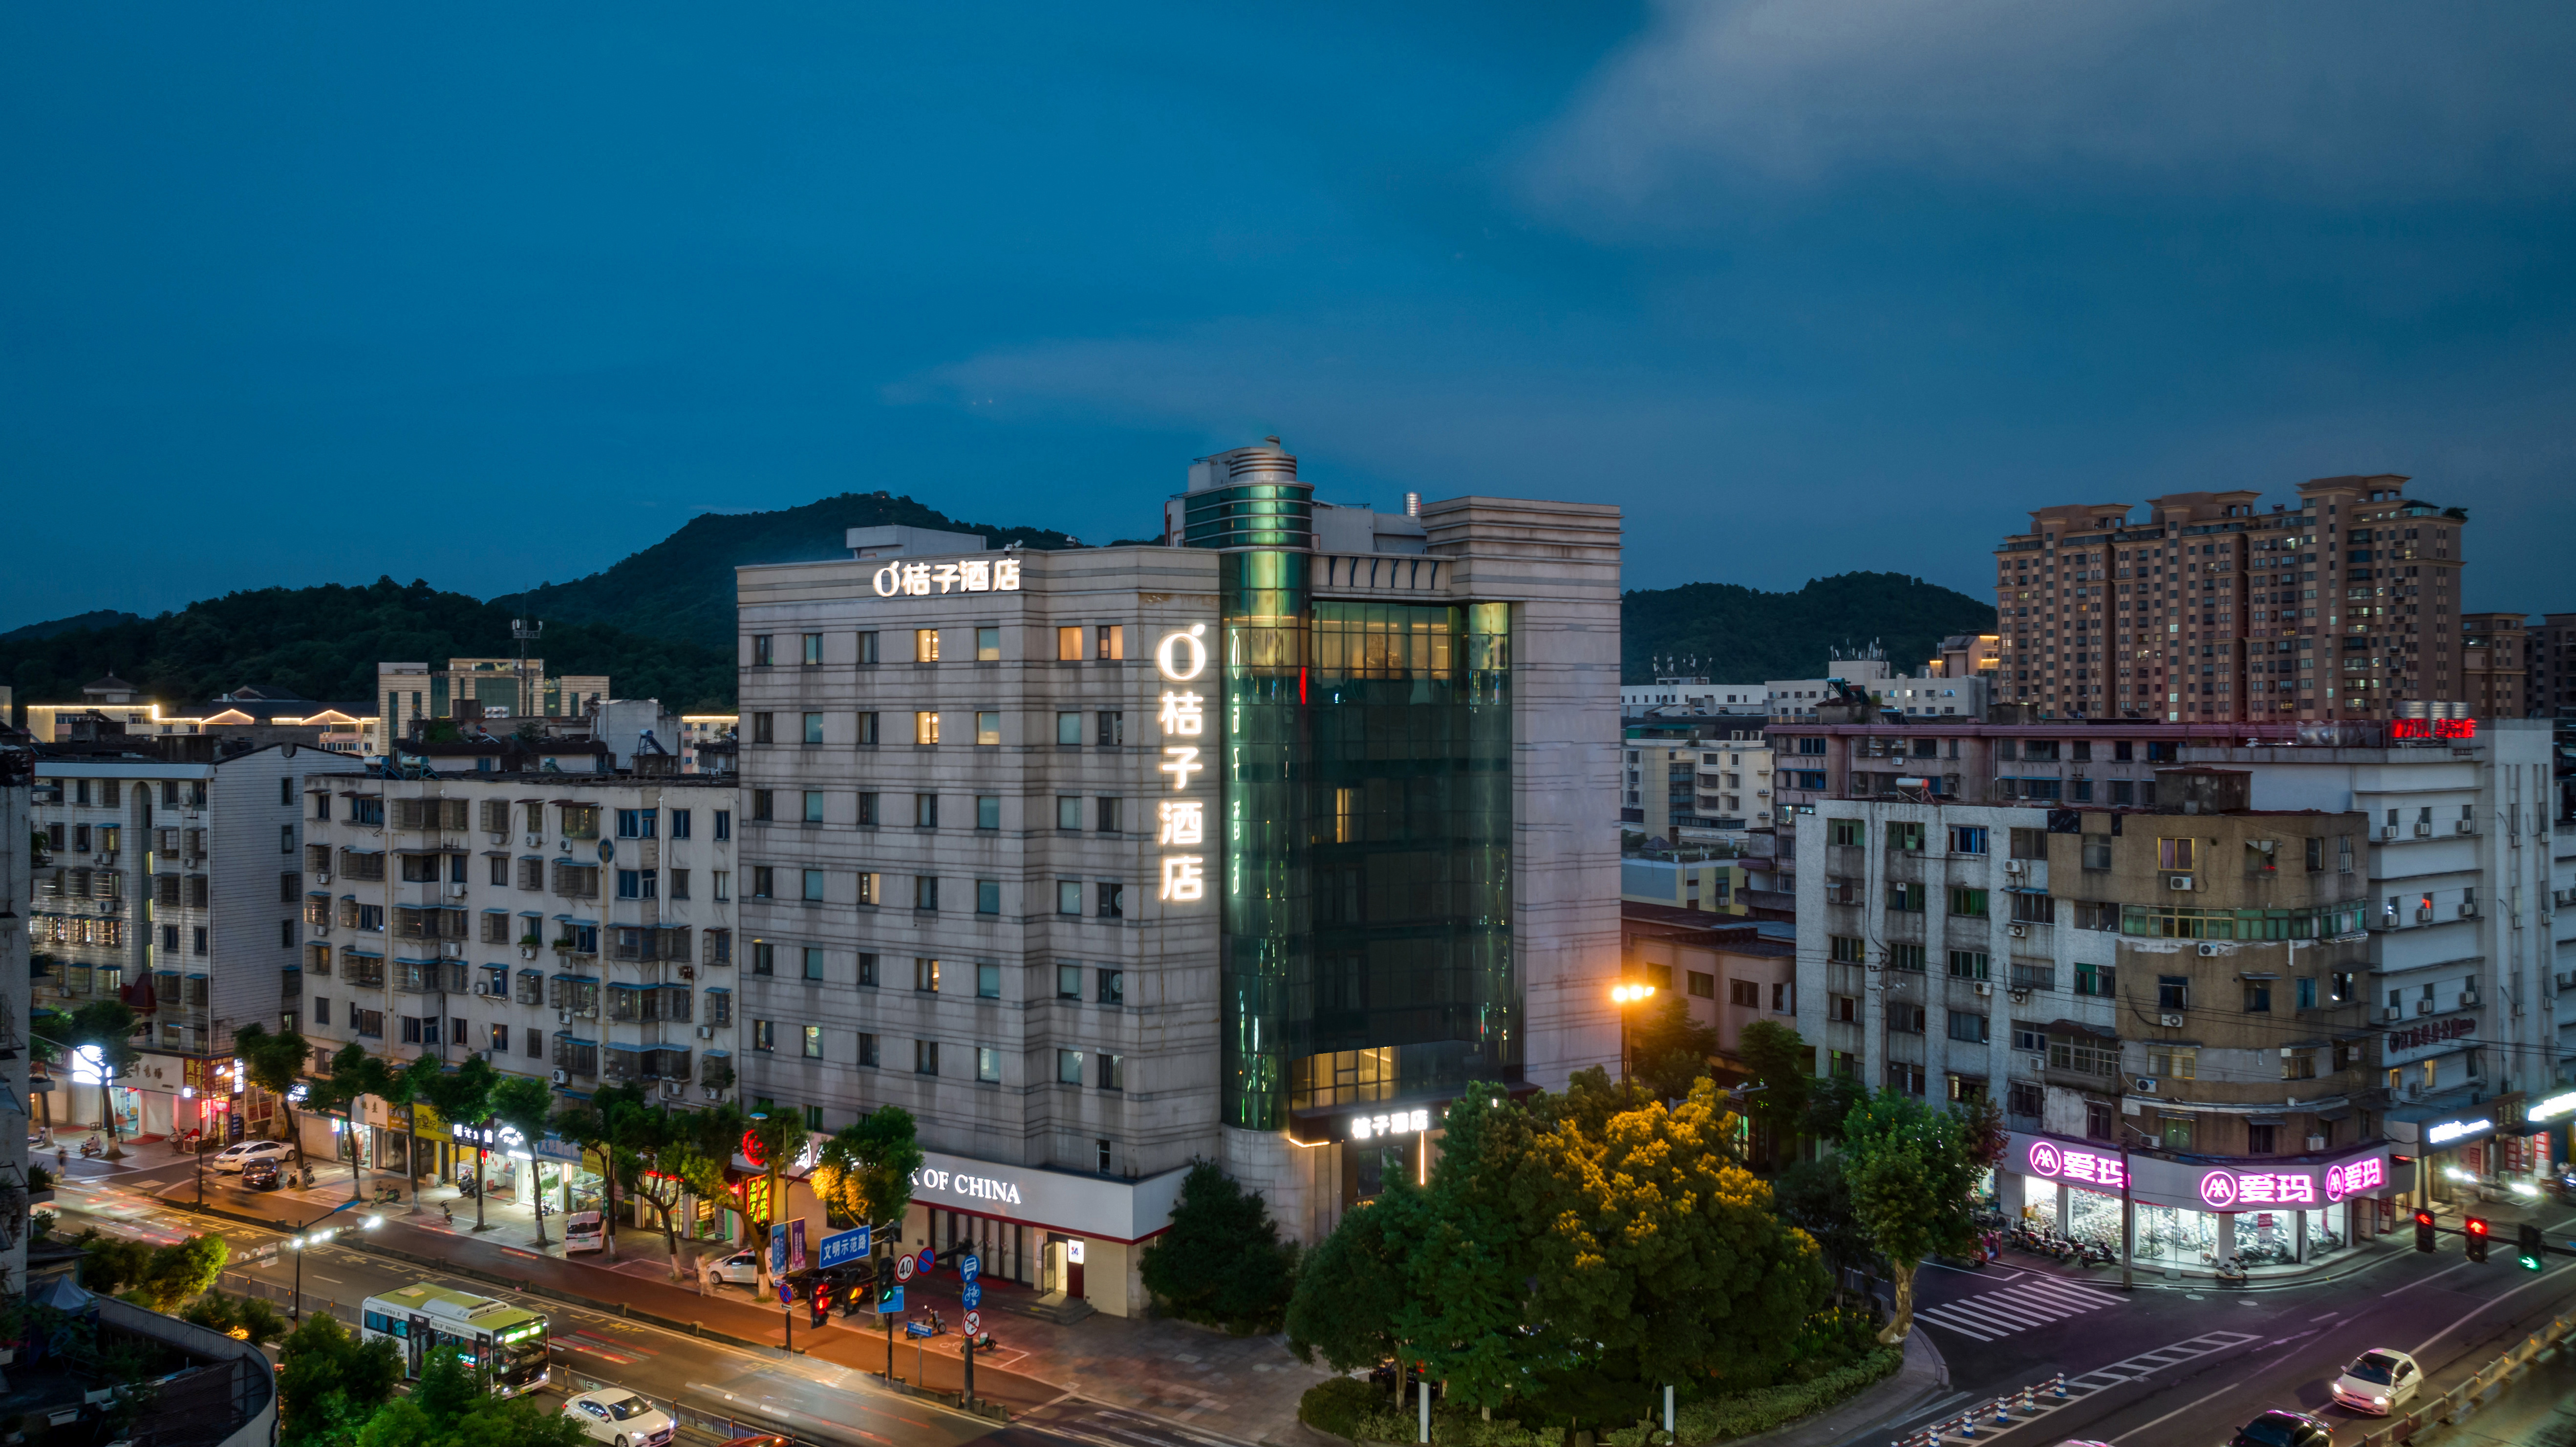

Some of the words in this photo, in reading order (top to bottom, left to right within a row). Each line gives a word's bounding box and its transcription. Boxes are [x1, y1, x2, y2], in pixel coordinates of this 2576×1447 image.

[902, 558, 1021, 596] 桔子酒店
[1160, 691, 1205, 902] 桔子酒店
[186, 1059, 206, 1075] 黄金
[186, 1075, 206, 1090] 回收
[1352, 1110, 1428, 1139] 桔子酒店
[2063, 1150, 2131, 1189] 爱玛
[2344, 1157, 2381, 1193] 爱玛
[923, 1169, 949, 1191] OF
[954, 1174, 1022, 1205] CHINA
[2239, 1173, 2314, 1203] 爱玛
[823, 1233, 866, 1261] 文明示范路
[899, 1259, 912, 1276] 40
